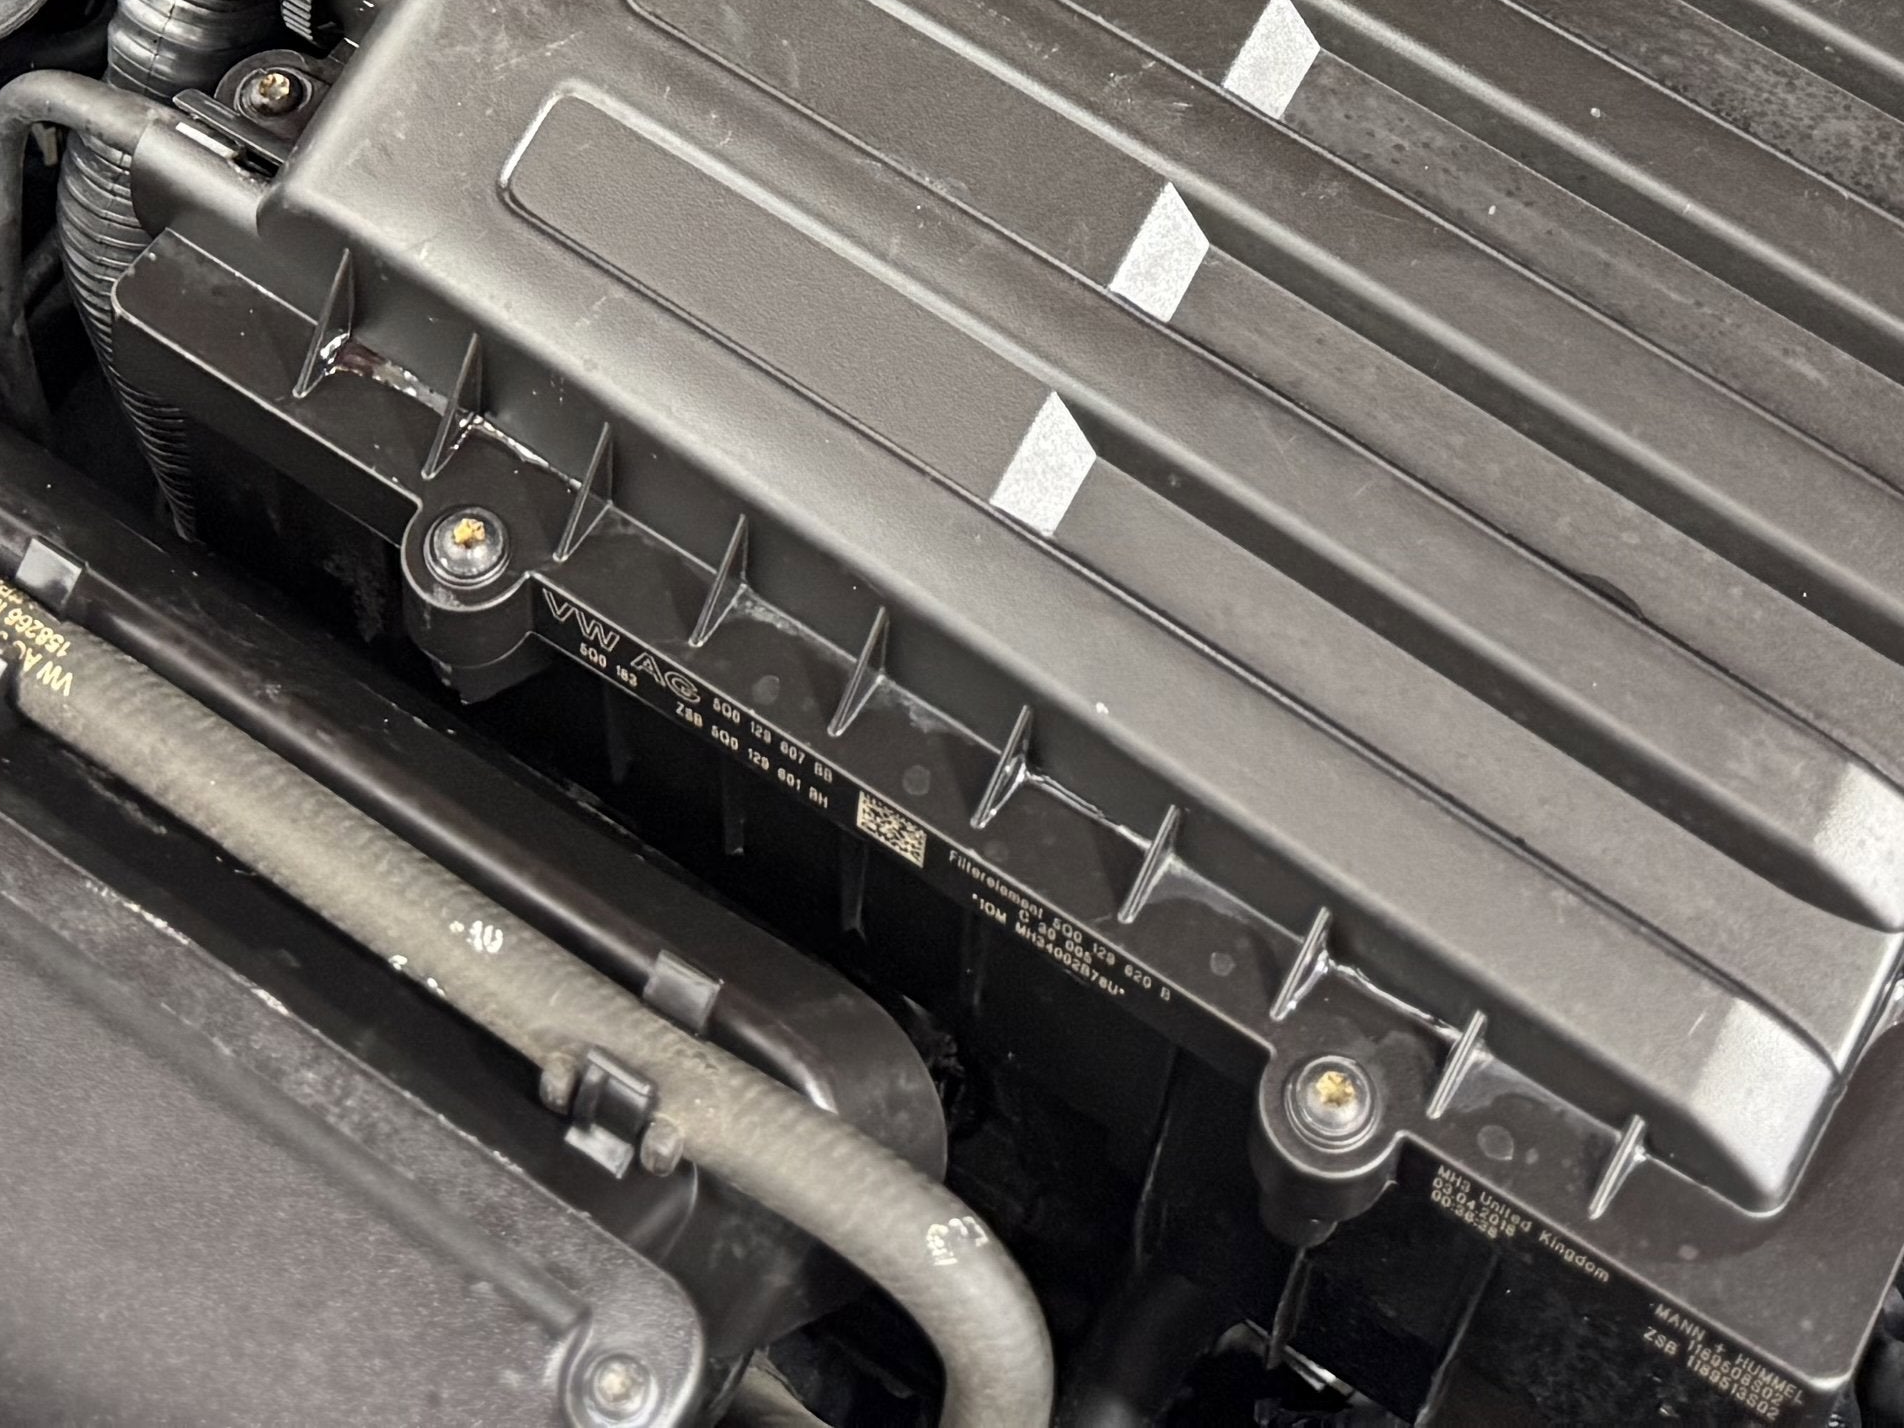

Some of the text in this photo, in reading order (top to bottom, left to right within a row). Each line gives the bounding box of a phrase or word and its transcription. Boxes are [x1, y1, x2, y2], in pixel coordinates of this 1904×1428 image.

[2, 604, 73, 659] 158266
[542, 587, 700, 710] VW AG
[34, 657, 79, 698] VW
[949, 848, 1043, 921] Filterelement
[1124, 961, 1151, 992] 620
[1018, 908, 1029, 925] C
[1432, 1174, 1517, 1239] 03.04.2018
[1479, 1190, 1532, 1234] United
[1538, 1228, 1609, 1284] Kingdom
[1643, 1324, 1679, 1358] ZSB
[1654, 1301, 1804, 1405] MANN + HUMMEL
